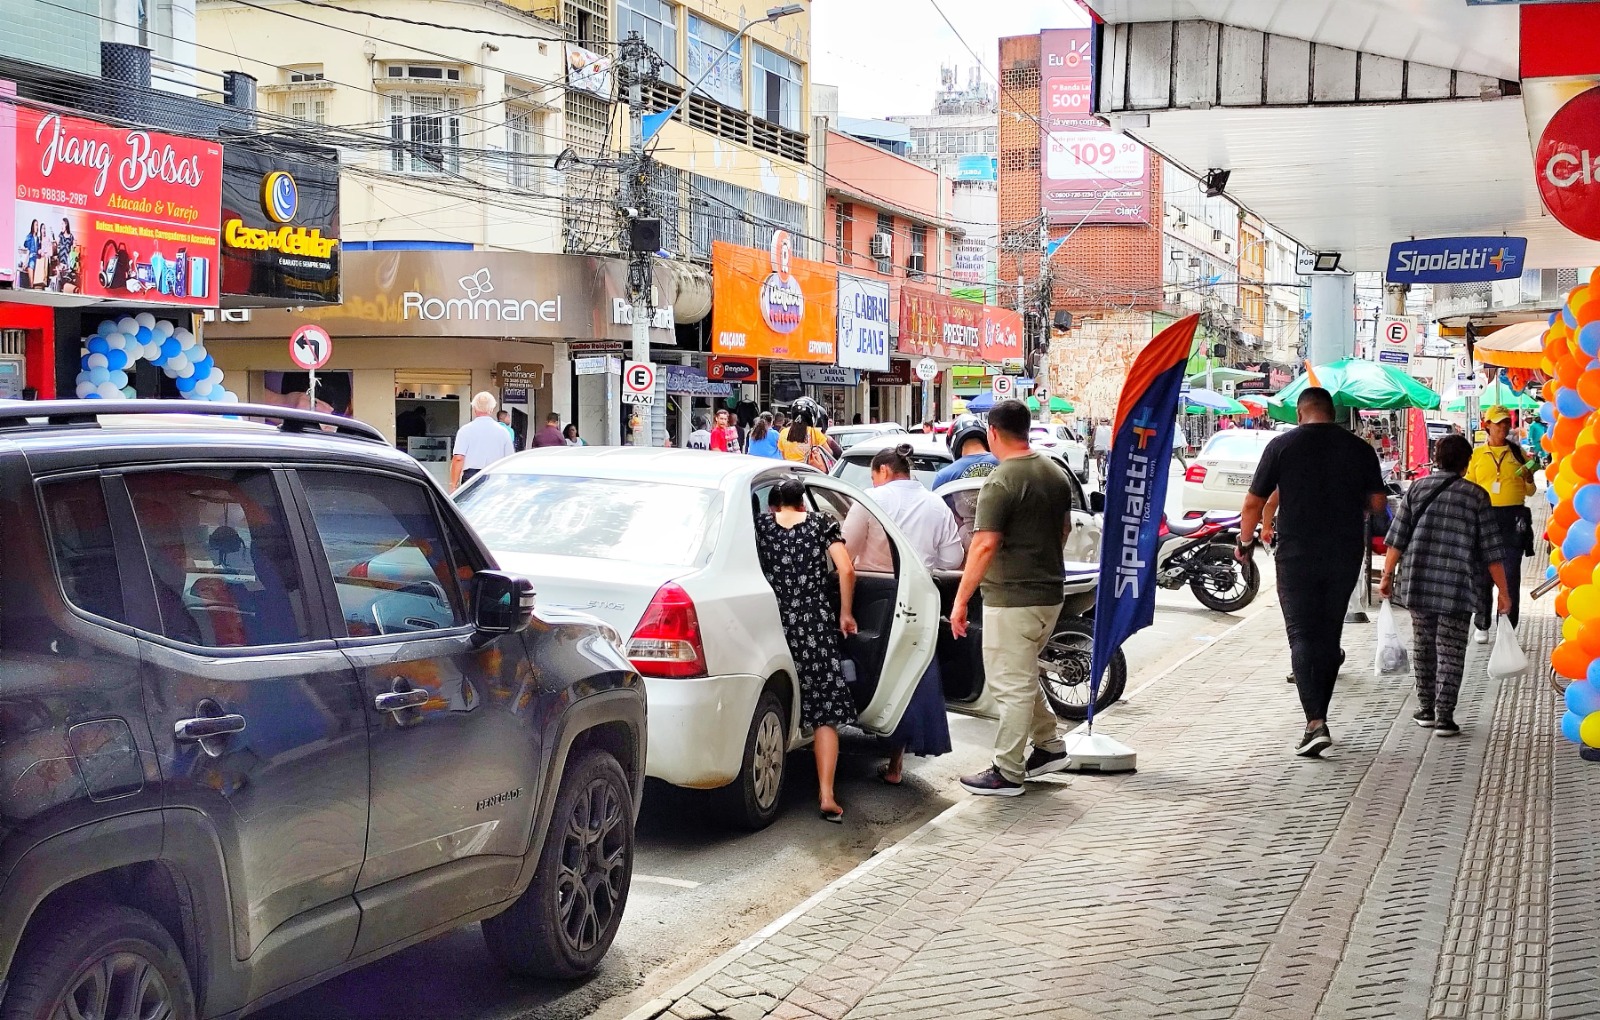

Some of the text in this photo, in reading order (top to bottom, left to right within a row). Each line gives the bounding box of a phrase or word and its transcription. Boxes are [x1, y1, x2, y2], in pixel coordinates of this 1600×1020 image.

[1052, 93, 1082, 107] 500
[35, 113, 203, 197] Jiang Bolsas
[1052, 145, 1064, 153] R$
[1071, 143, 1116, 165] 109
[41, 187, 89, 206] 98838-2987
[107, 193, 199, 224] Atacado & Varejo
[1114, 206, 1141, 216] Claro
[226, 219, 269, 251] Casa
[280, 226, 337, 259] Celular
[1396, 248, 1488, 275] Sipolatti
[403, 291, 562, 322] Rommanel
[855, 292, 889, 324] CABRAL
[857, 328, 884, 356] JEANS
[943, 322, 979, 348] PRESENTES
[1391, 326, 1403, 340] E
[502, 369, 537, 379] Rommanel
[634, 370, 645, 386] E
[819, 368, 847, 376] CABRAL
[999, 380, 1007, 390] E
[623, 394, 654, 404] TAXI
[1114, 453, 1149, 600] Sipolatti
[587, 600, 625, 611] ETIOS
[475, 787, 524, 812] RENEGADE
